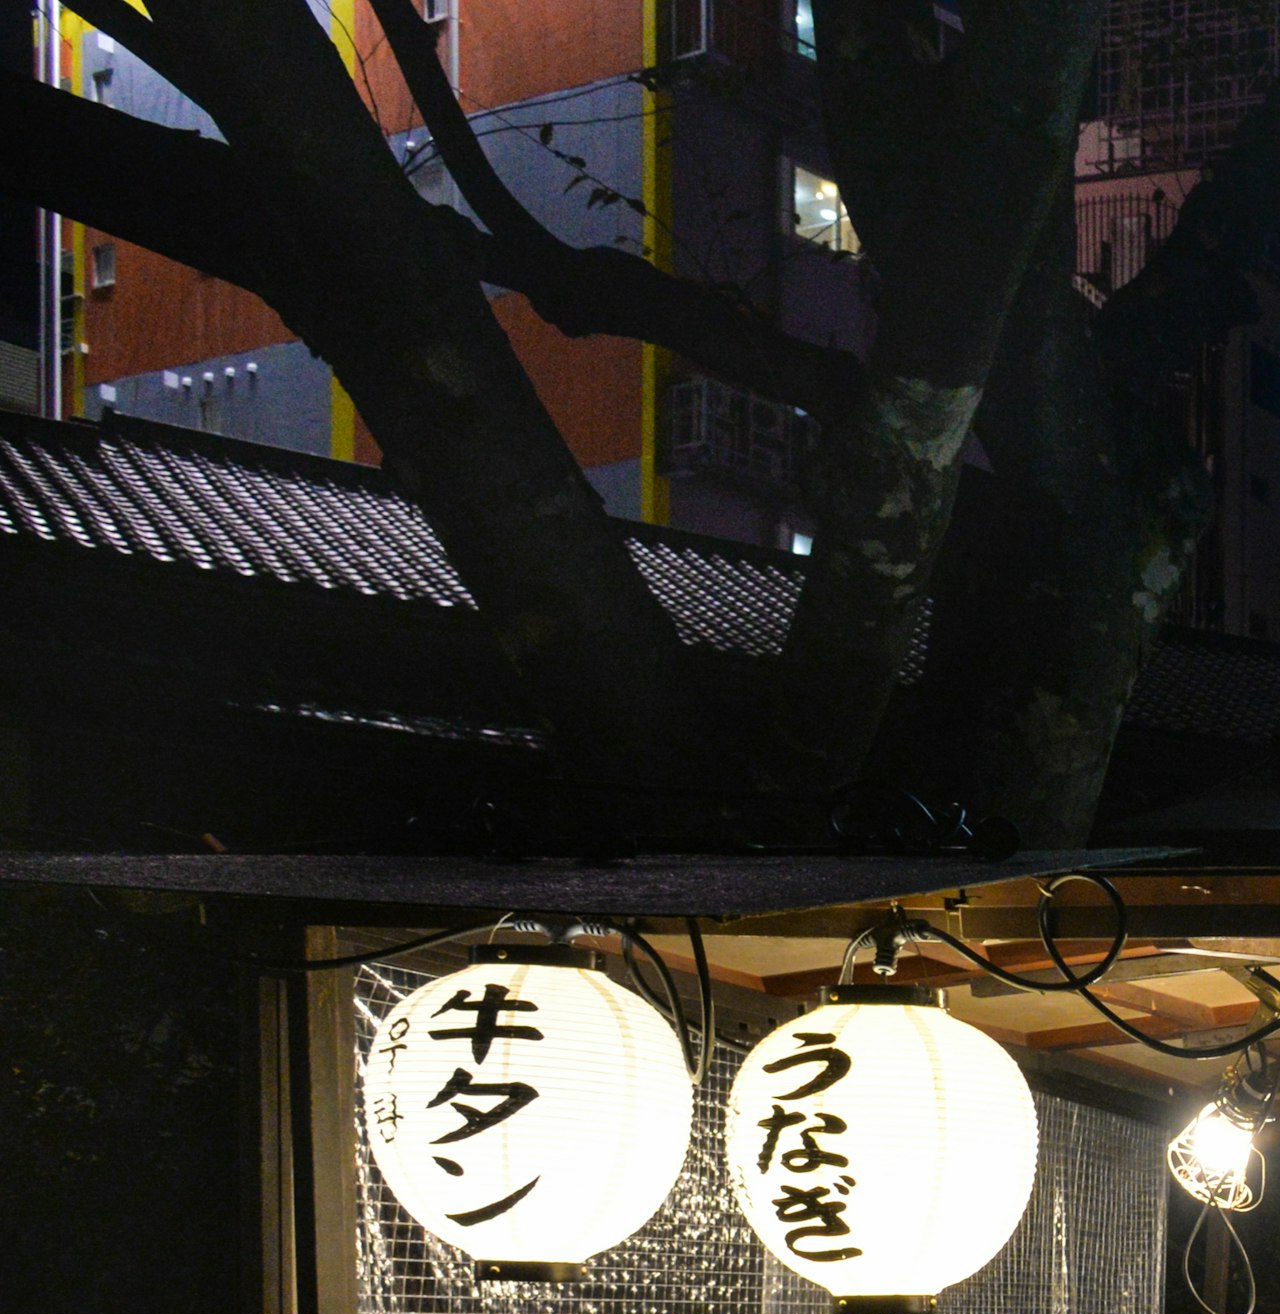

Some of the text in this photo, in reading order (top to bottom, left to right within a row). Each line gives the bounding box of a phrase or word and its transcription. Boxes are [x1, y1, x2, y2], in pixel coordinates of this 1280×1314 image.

[427, 984, 544, 1227] 牛タン
[757, 1032, 862, 1262] うなぎ
